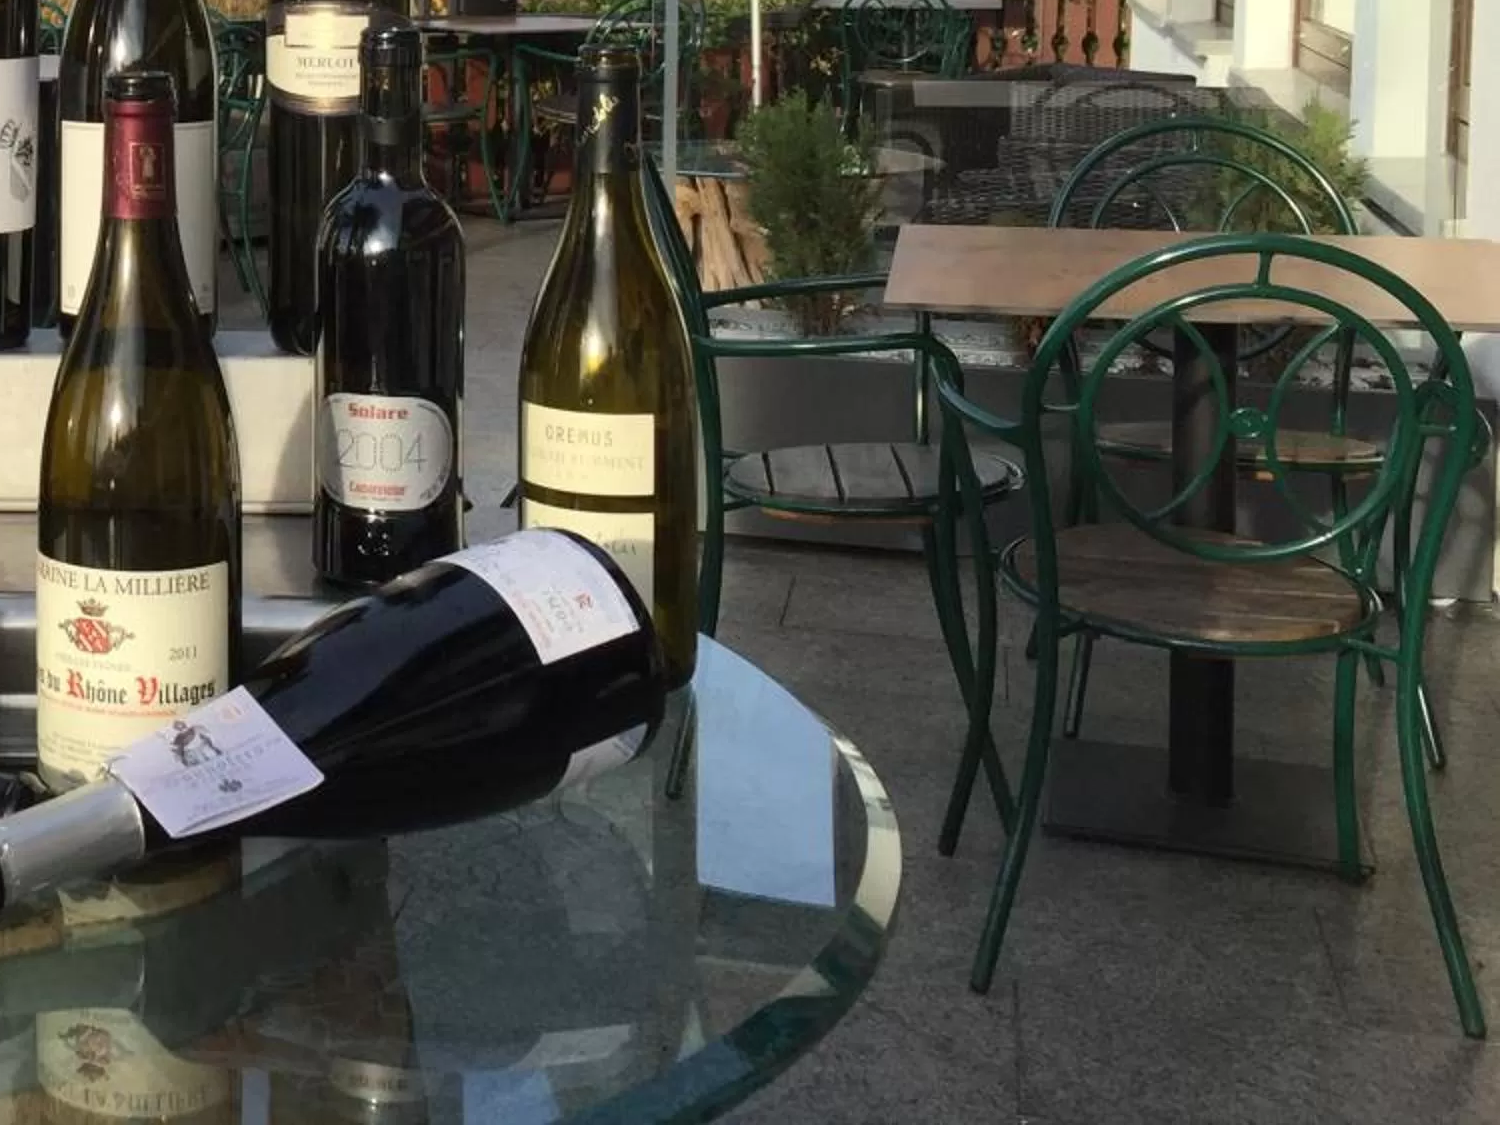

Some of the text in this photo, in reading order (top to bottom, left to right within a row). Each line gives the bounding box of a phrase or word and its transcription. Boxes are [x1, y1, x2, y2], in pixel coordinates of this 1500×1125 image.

[334, 427, 428, 475] 2004
[83, 574, 108, 595] LA
[66, 668, 128, 705] Rhône
[135, 674, 217, 706] Villages
